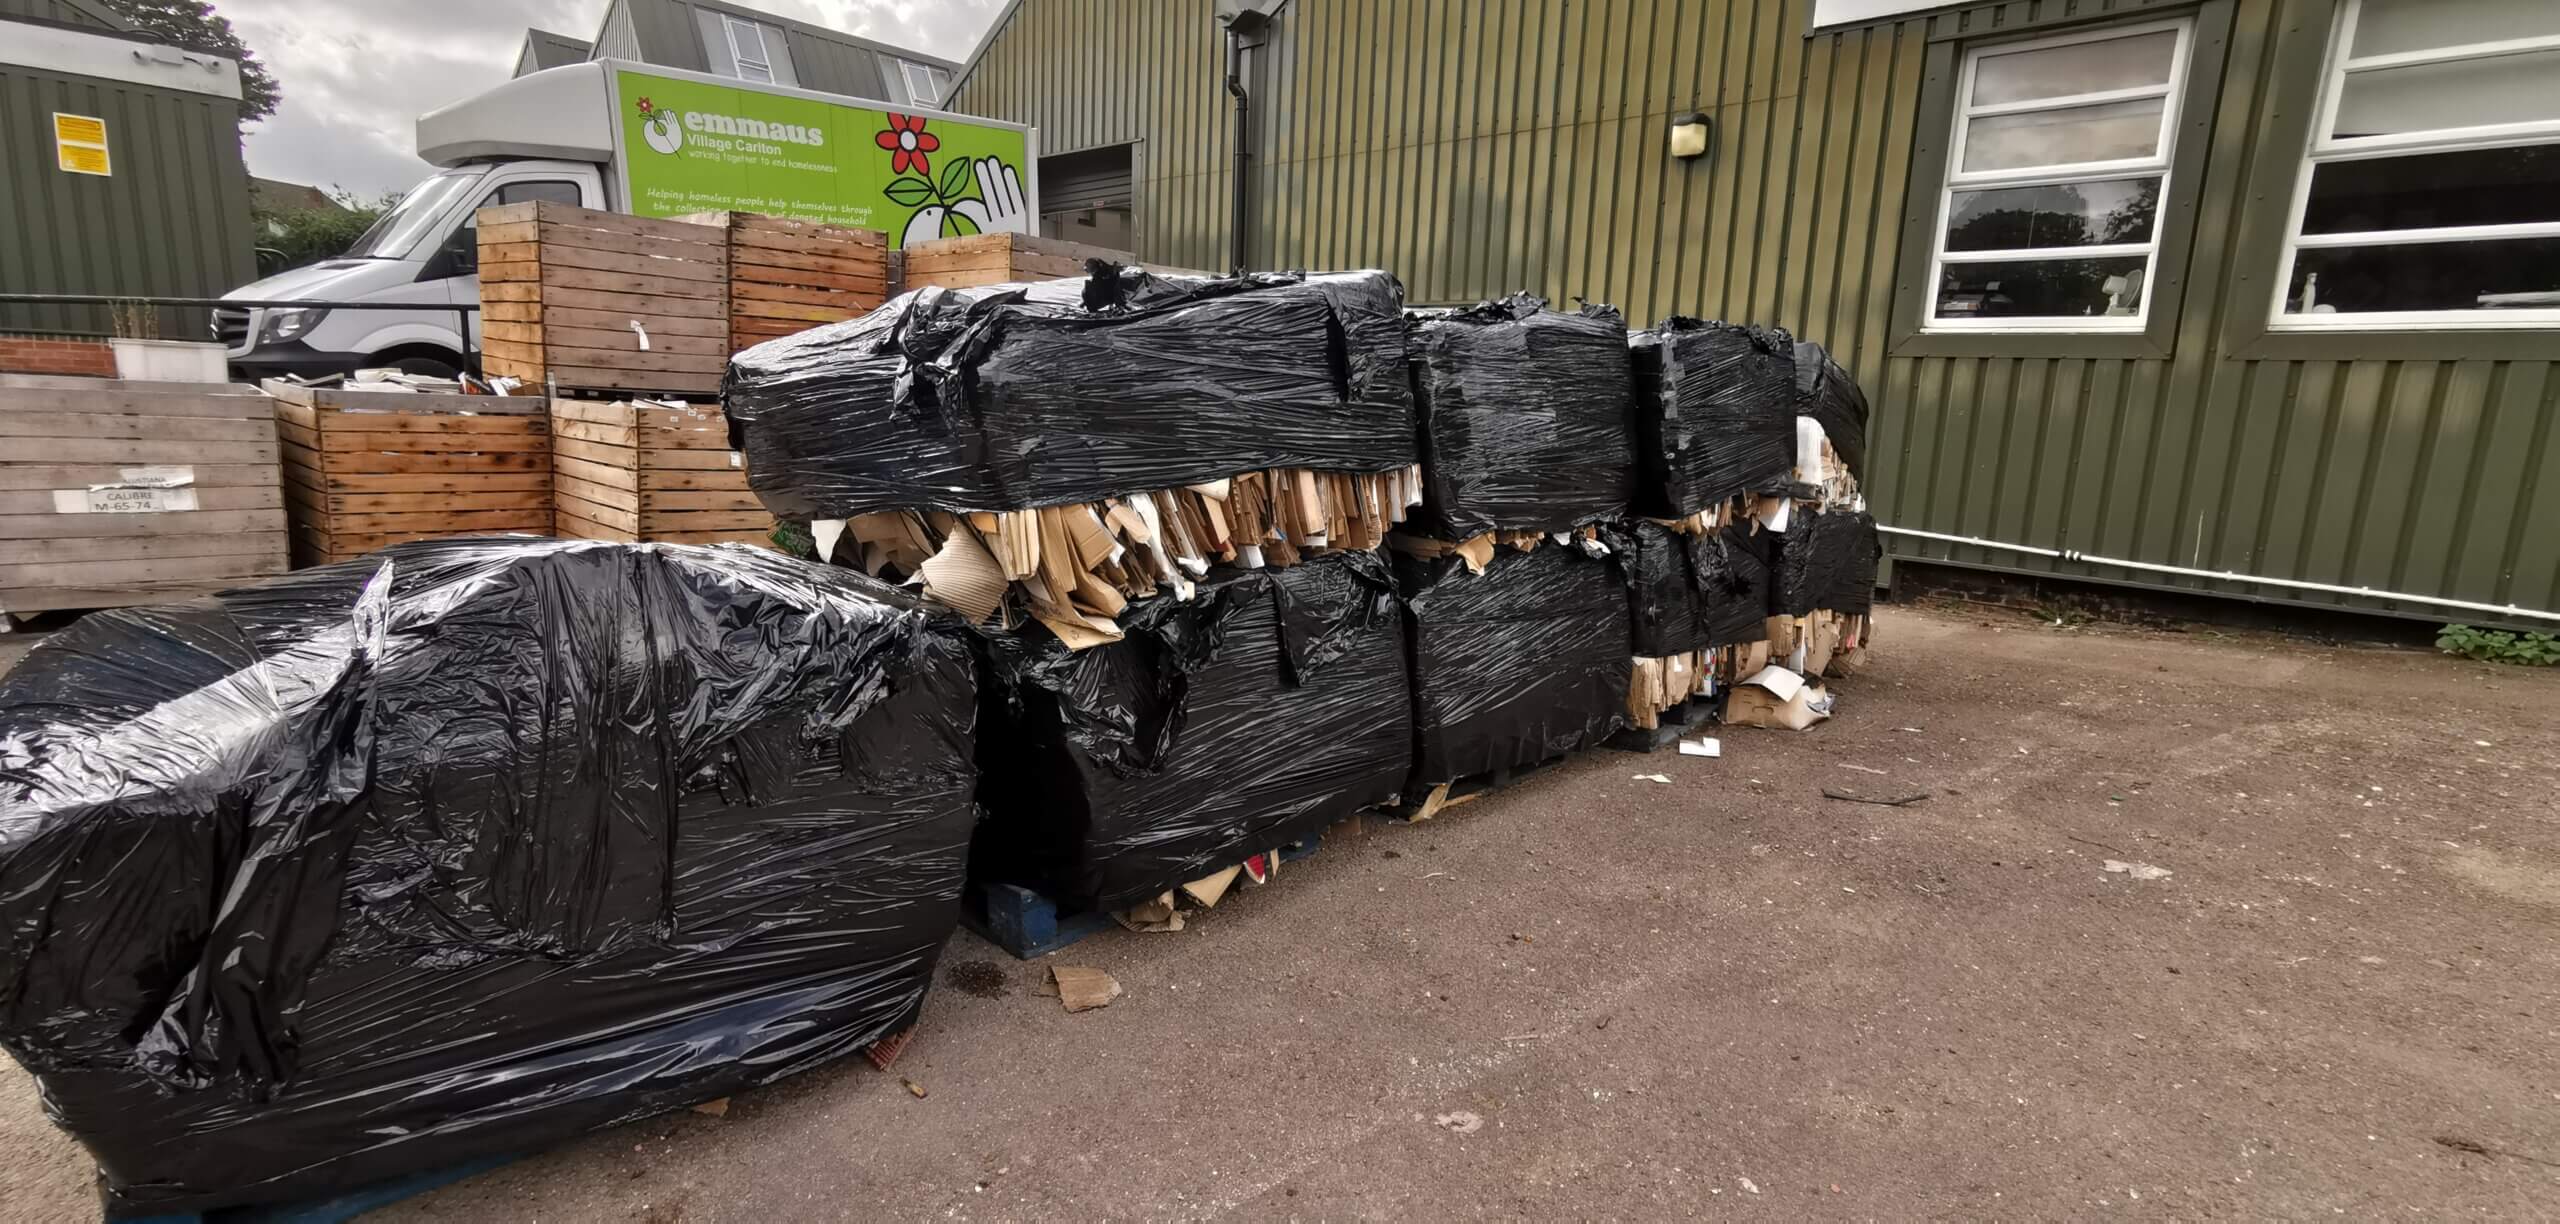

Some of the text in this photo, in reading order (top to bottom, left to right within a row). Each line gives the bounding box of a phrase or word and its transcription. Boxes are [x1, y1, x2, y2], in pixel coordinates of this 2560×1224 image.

[684, 111, 824, 146] emmaus
[687, 133, 782, 156] Village Carlton
[688, 150, 720, 162] working
[761, 156, 770, 166] to
[772, 157, 786, 168] end
[647, 187, 872, 217] Helping homeless people help themselves through
[653, 202, 671, 211] the
[827, 214, 866, 225] household
[107, 491, 152, 501] CALIBRE
